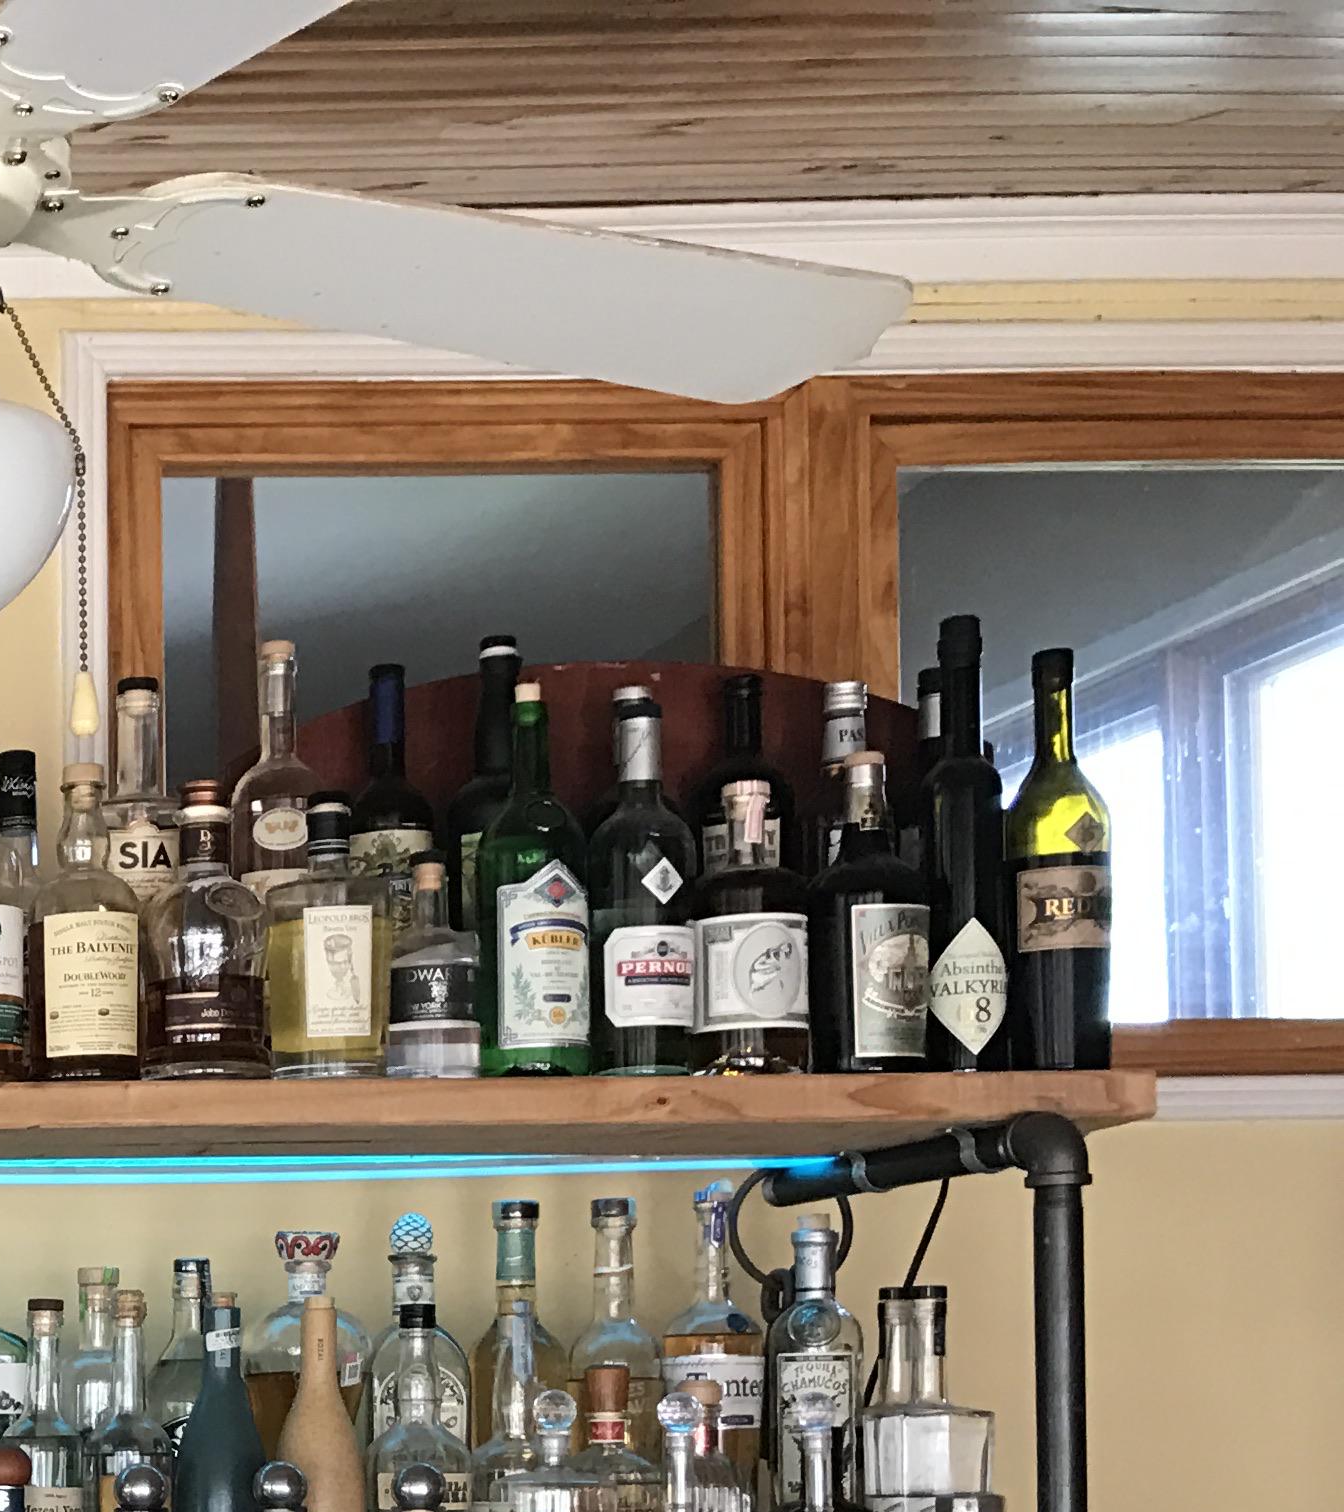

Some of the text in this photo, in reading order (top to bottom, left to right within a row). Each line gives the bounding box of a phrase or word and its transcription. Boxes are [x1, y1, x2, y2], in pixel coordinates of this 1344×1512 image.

[119, 841, 171, 869] SIA
[1045, 897, 1090, 919] RED
[50, 946, 73, 956] THE
[63, 971, 127, 983] DOUBLEWOOD
[975, 997, 992, 1023] 8
[781, 1377, 848, 1394] CHAMUCOS
